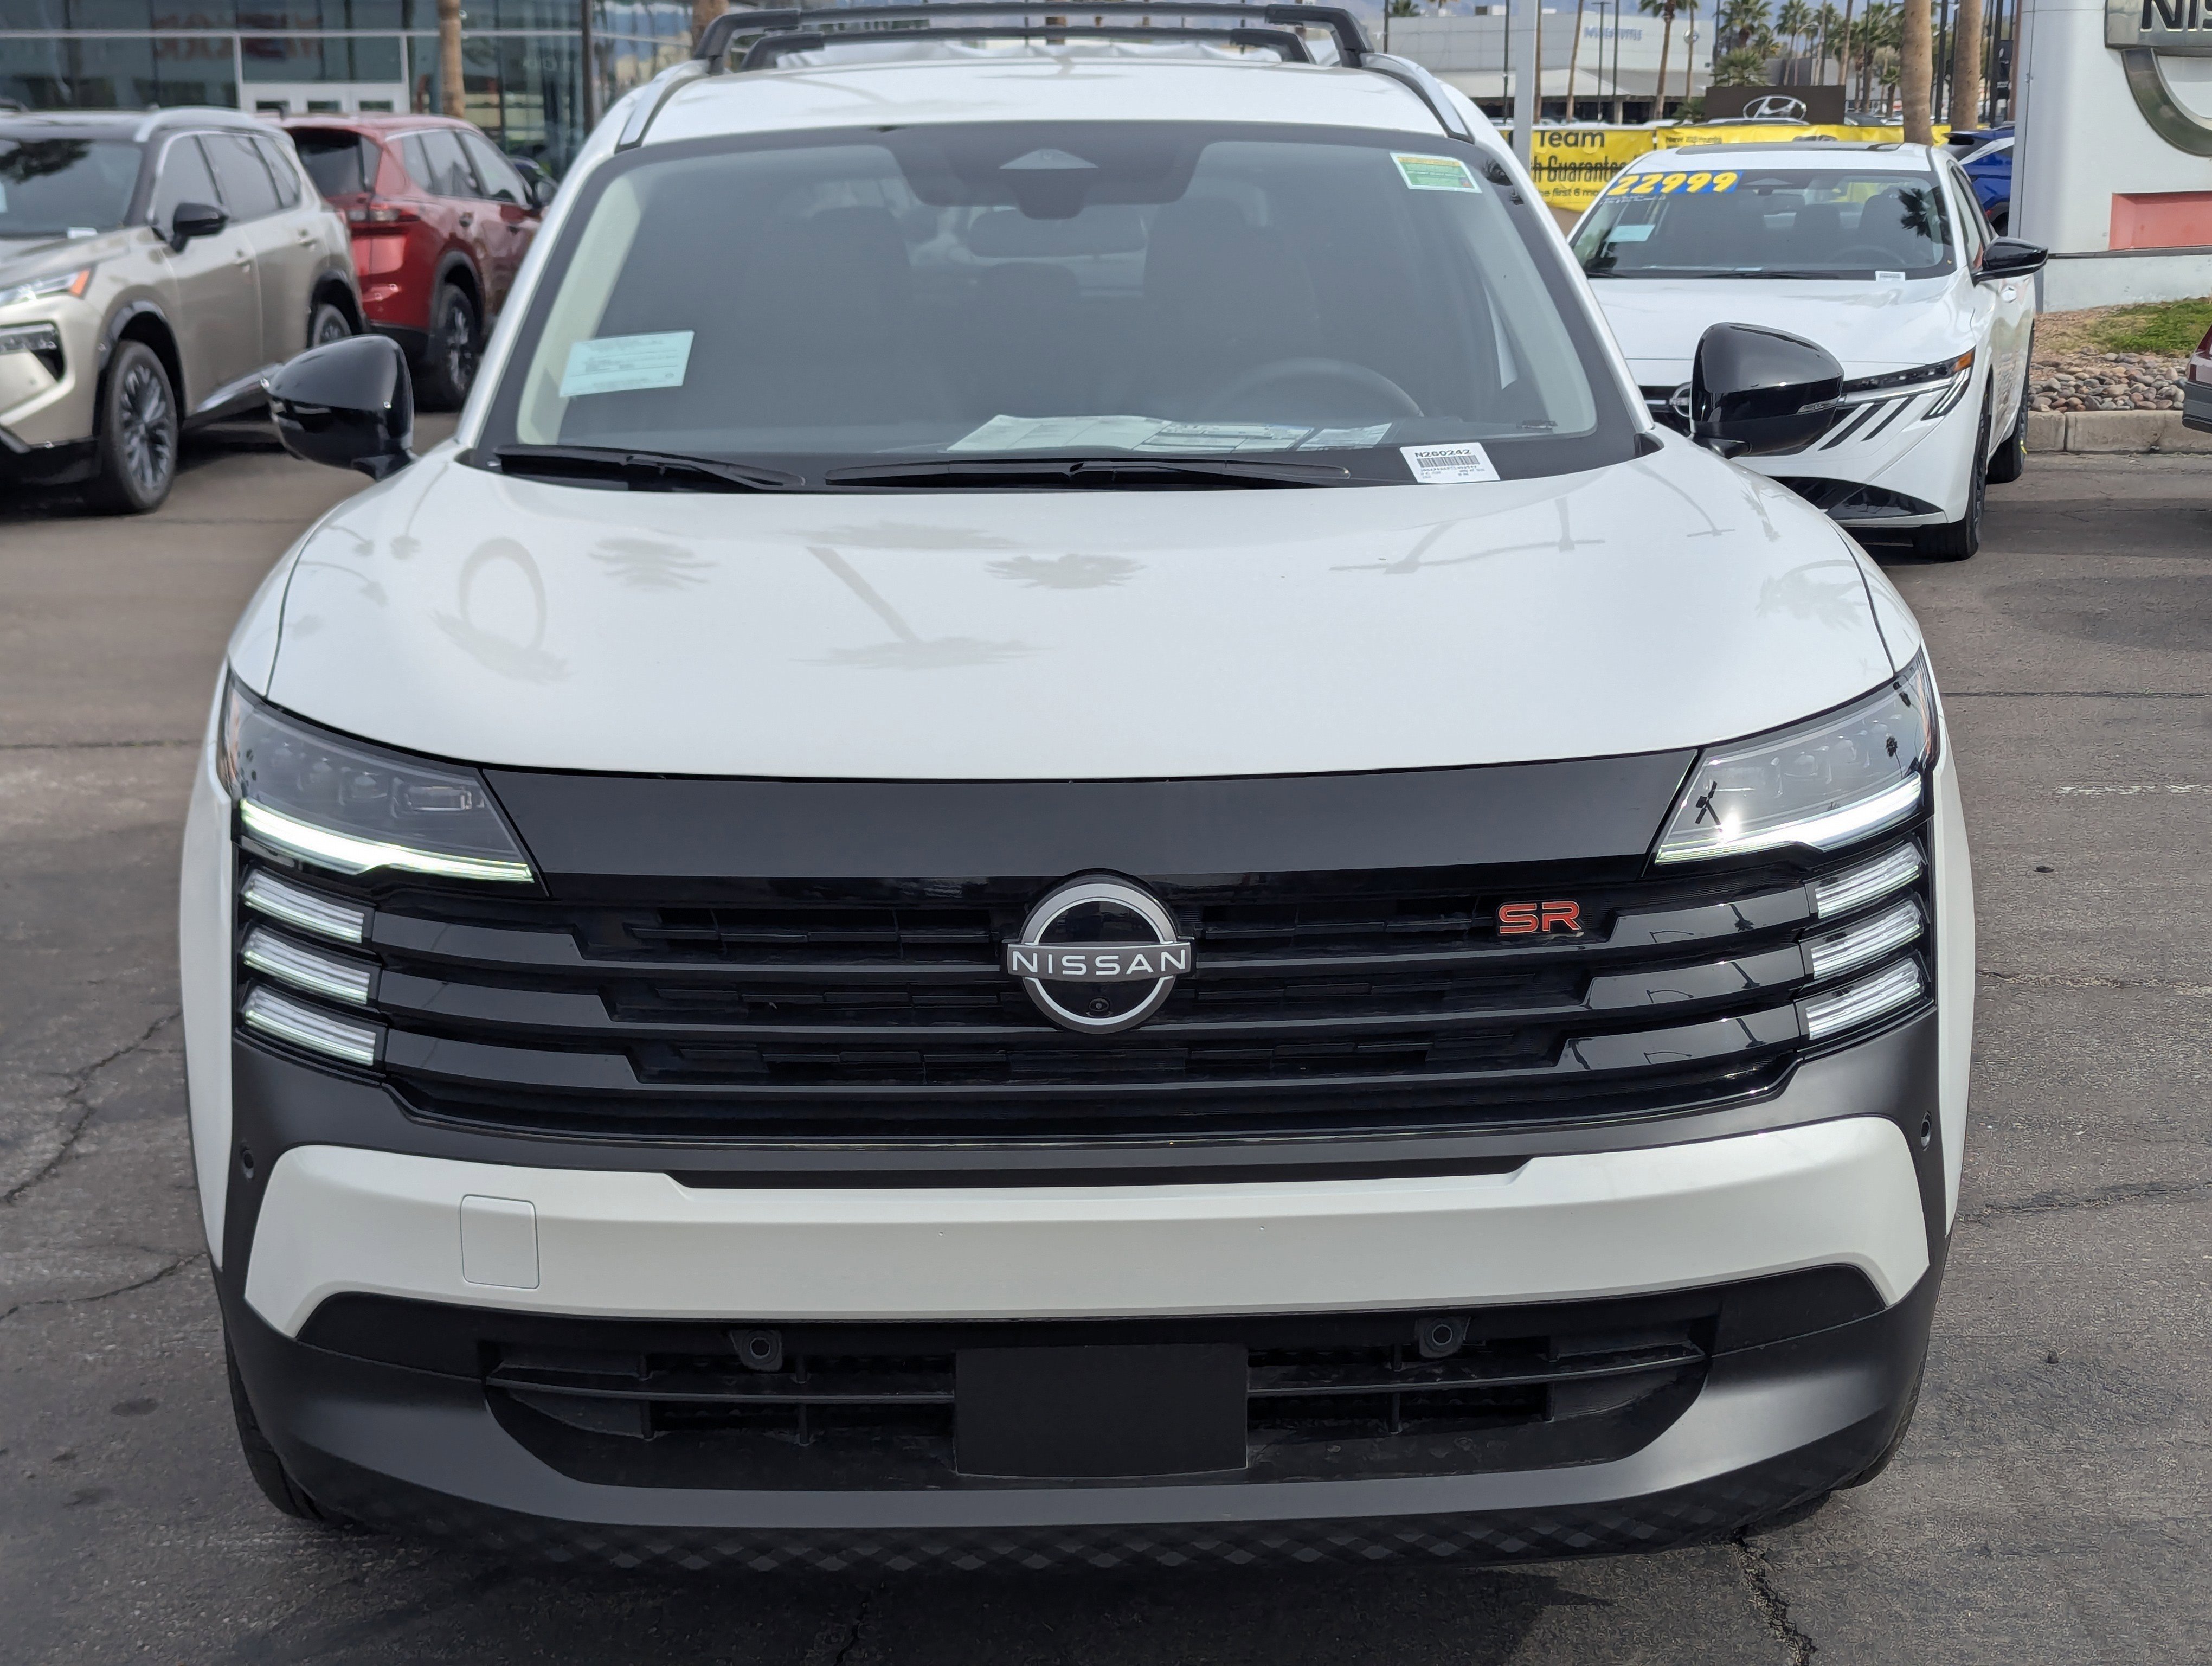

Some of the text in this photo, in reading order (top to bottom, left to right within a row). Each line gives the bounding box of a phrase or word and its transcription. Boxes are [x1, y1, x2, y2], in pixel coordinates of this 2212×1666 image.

[1539, 130, 1605, 148] Team
[1573, 188, 1580, 197] 6
[1607, 172, 1738, 196] 22999
[1414, 449, 1470, 458] N260242
[1499, 900, 1582, 934] SR
[1012, 949, 1186, 976] NISSAN
